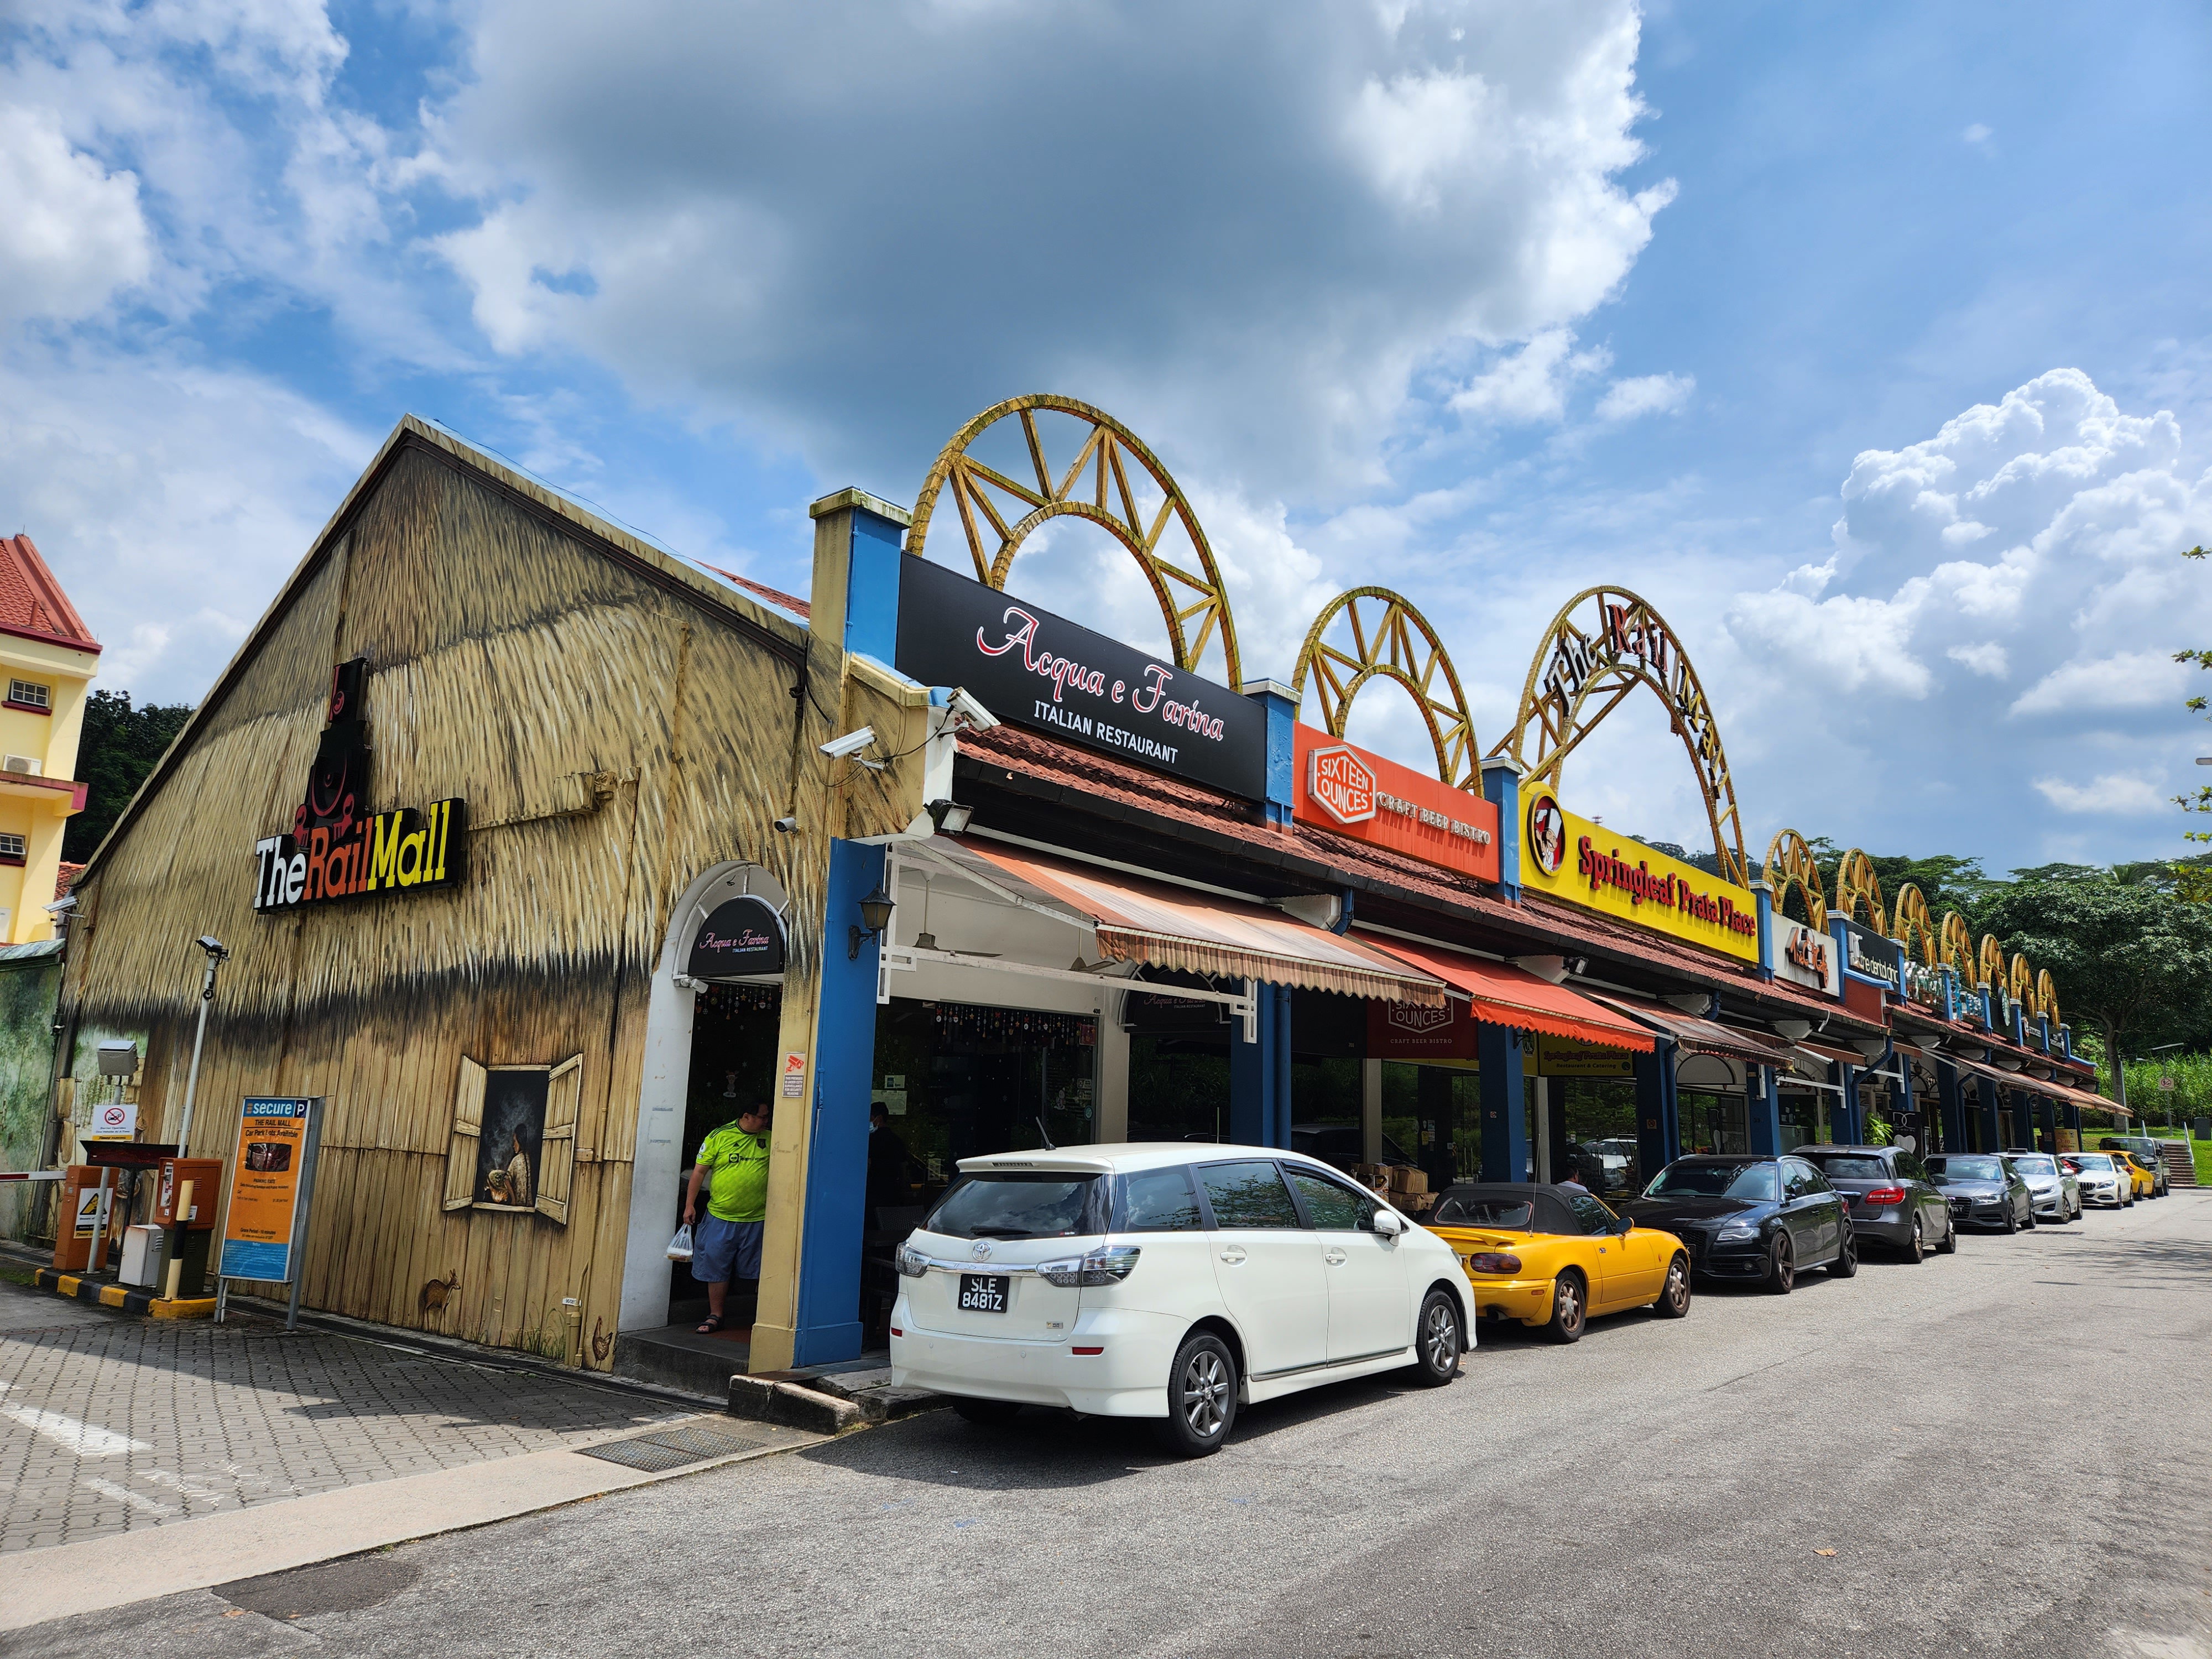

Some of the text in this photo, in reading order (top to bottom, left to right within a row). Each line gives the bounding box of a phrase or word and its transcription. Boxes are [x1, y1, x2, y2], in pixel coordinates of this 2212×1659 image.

[977, 607, 1224, 741] Acqua e Farina
[1543, 604, 1729, 799] The Rail Mall
[1034, 700, 1178, 764] ITALIAN RESTAURANT
[1321, 755, 1368, 791] SIXTEEN
[1321, 779, 1368, 813] OUNCES
[1376, 791, 1490, 845] CRAFT BEER BISTRO
[1578, 835, 1756, 936] Springleaf Prata Place
[699, 932, 731, 953] Acqua
[738, 928, 769, 947] Farina
[1860, 951, 1870, 972] the
[1870, 956, 1887, 979] dental
[1887, 961, 1899, 984] clinic
[1144, 994, 1172, 1008] Acqua
[1396, 1010, 1446, 1027] OUNCES
[1544, 1051, 1629, 1061] Springleaf Prata Place
[253, 1103, 305, 1115] secure P
[962, 1292, 1003, 1310] 8481Z
[971, 1277, 997, 1293] SLE
